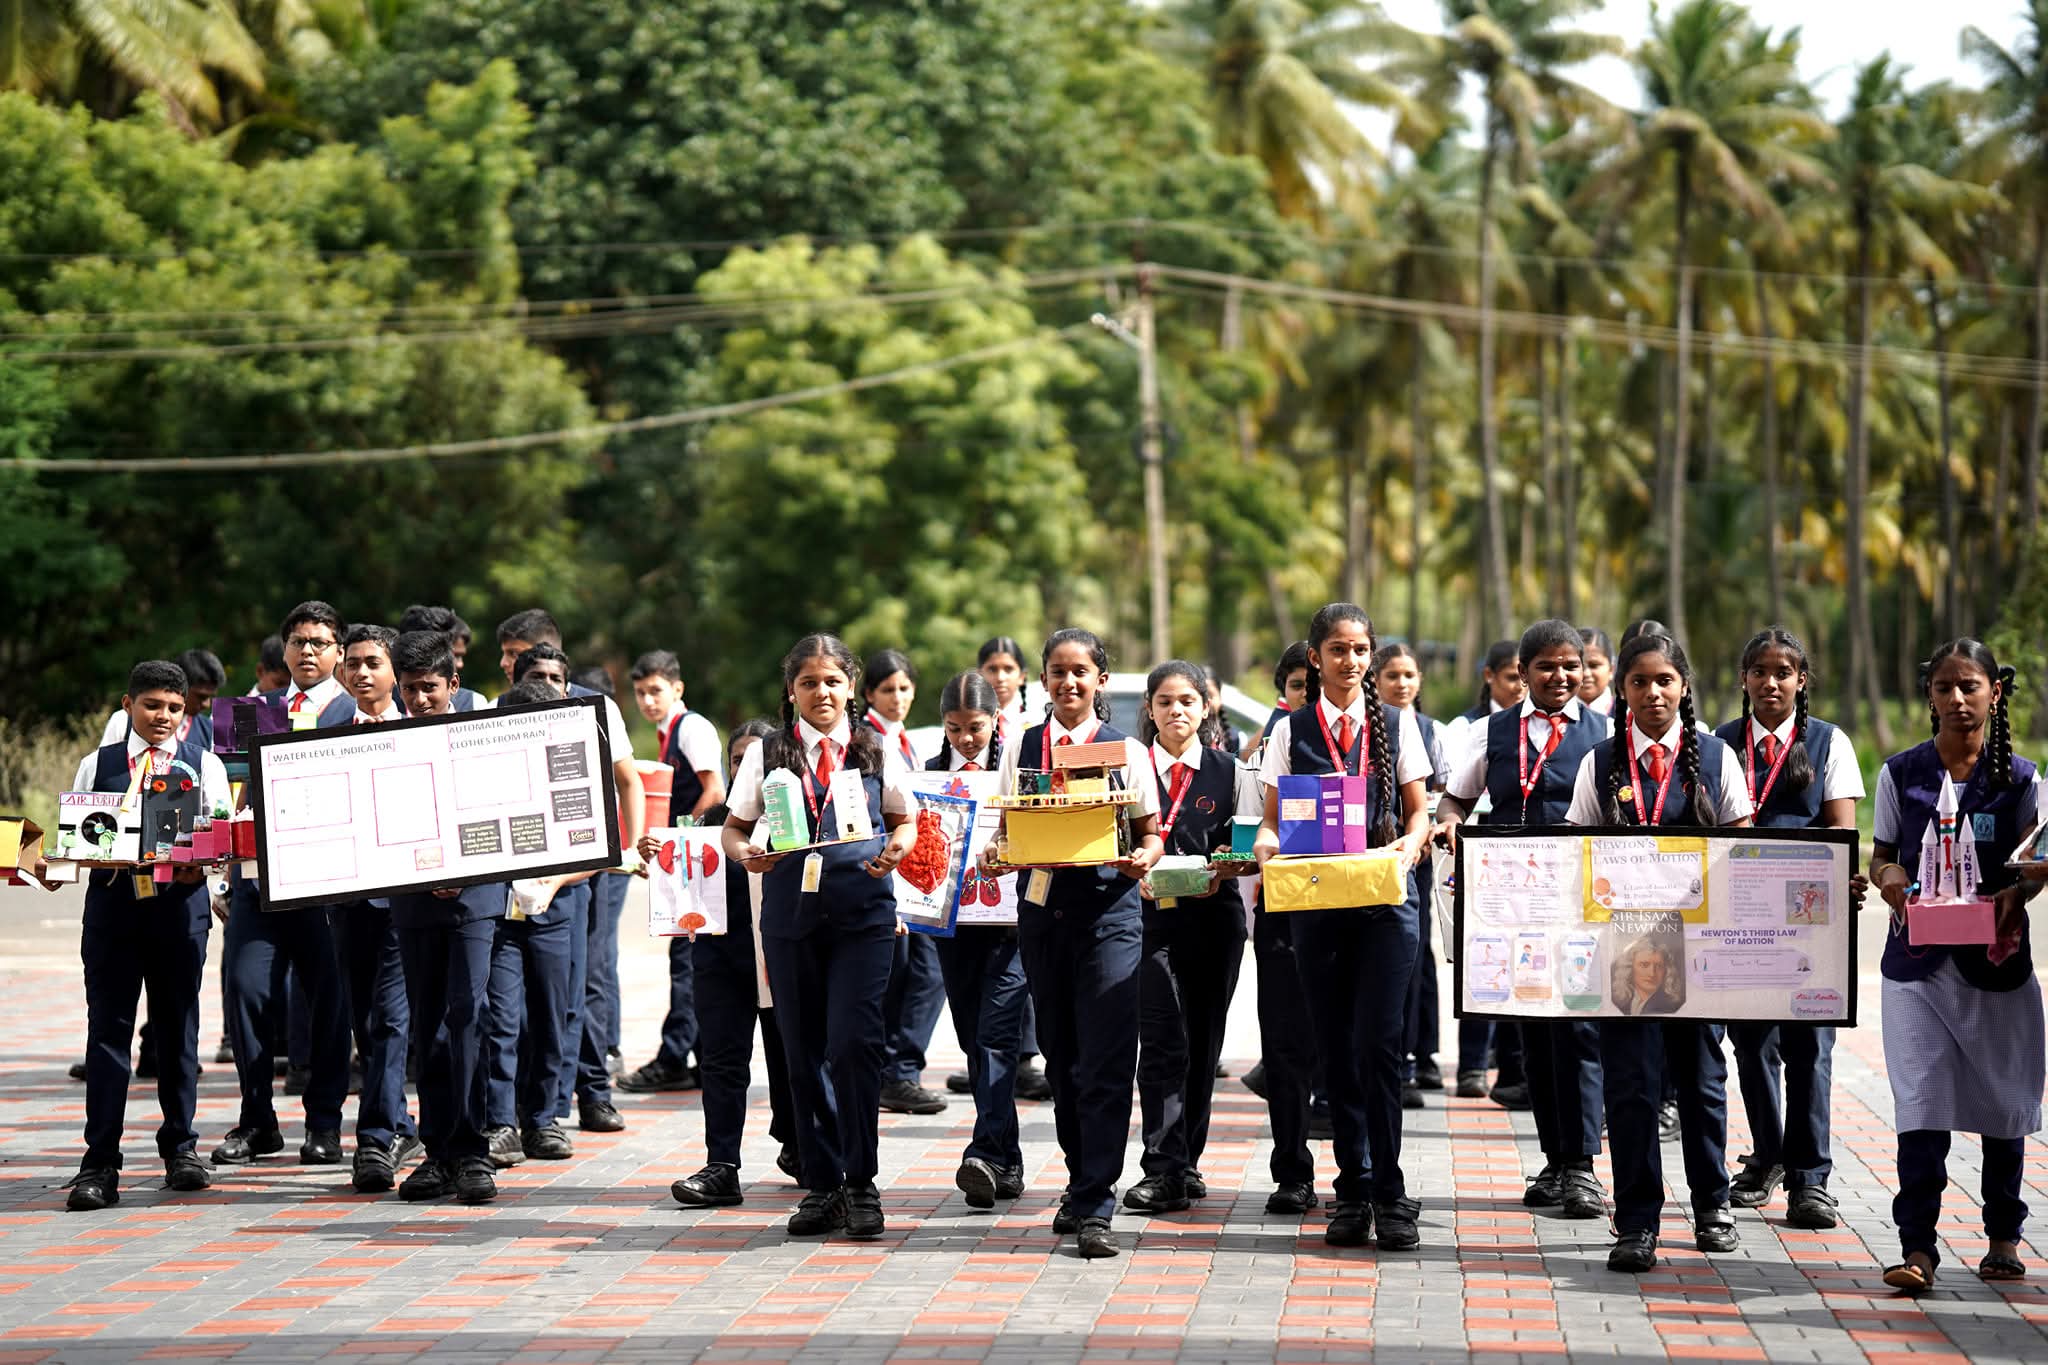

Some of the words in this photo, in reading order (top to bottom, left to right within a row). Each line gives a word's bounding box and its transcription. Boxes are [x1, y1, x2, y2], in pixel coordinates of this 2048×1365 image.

[449, 721, 504, 735] AUTOMATIC
[508, 712, 566, 726] PROTECTION
[569, 709, 581, 718] OF
[450, 737, 490, 750] CLOTHES
[493, 733, 521, 744] FROM
[273, 752, 307, 762] WATER
[309, 748, 336, 758] LEVEL
[340, 742, 392, 755] INDICATOR
[1593, 838, 1656, 849] NEWTON'S
[1594, 855, 1627, 864] LAWS
[1630, 856, 1647, 864] OF
[1650, 853, 1699, 863] MOTION
[1964, 845, 1972, 888] INDIA
[1612, 911, 1633, 921] SIR
[1640, 911, 1679, 921] ISAAC
[1614, 922, 1678, 933] NEWTON
[1701, 929, 1748, 937] NEWTON'S
[1749, 929, 1776, 937] THIRD
[1777, 929, 1797, 937] LAW
